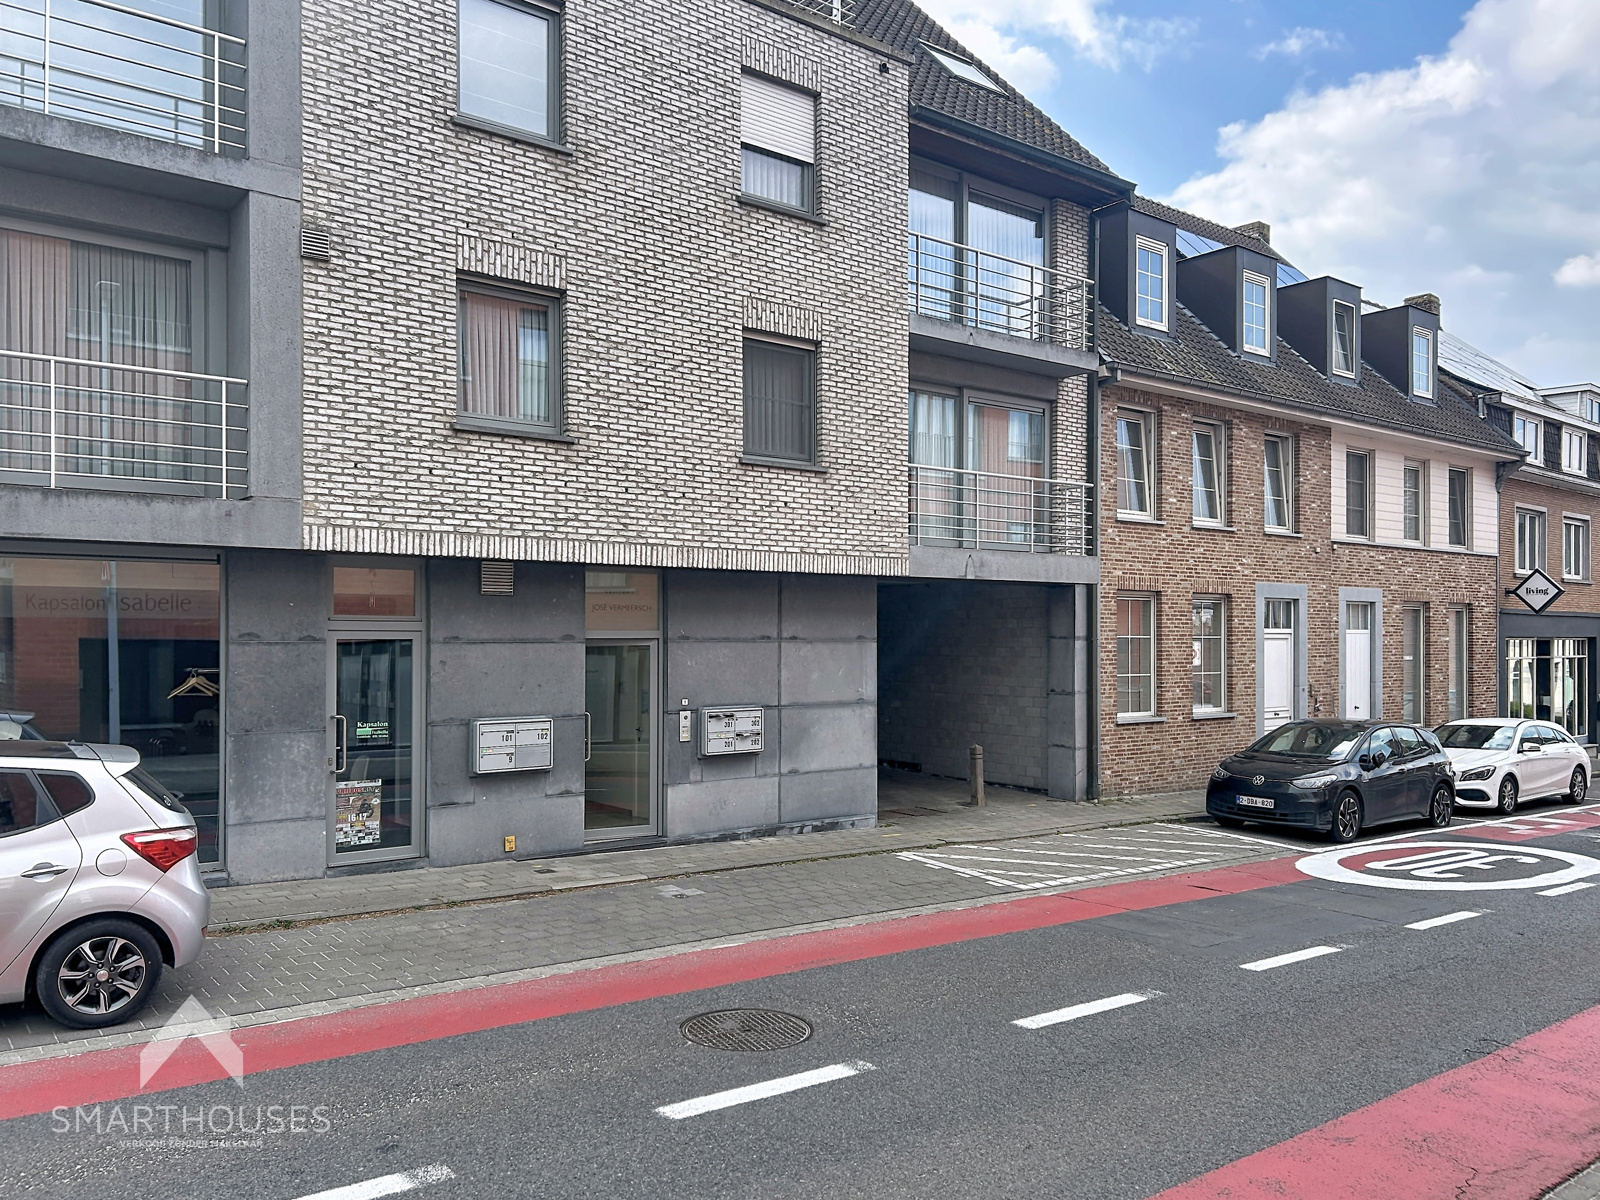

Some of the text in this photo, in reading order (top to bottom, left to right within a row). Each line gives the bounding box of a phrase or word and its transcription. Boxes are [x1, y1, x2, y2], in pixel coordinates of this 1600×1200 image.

[1525, 587, 1549, 595] living
[25, 592, 192, 613] Kapsalon Isabelle
[609, 604, 652, 612] VERMEERSCH
[357, 721, 389, 729] Kapsalon
[501, 734, 513, 742] 101
[537, 732, 549, 740] 102
